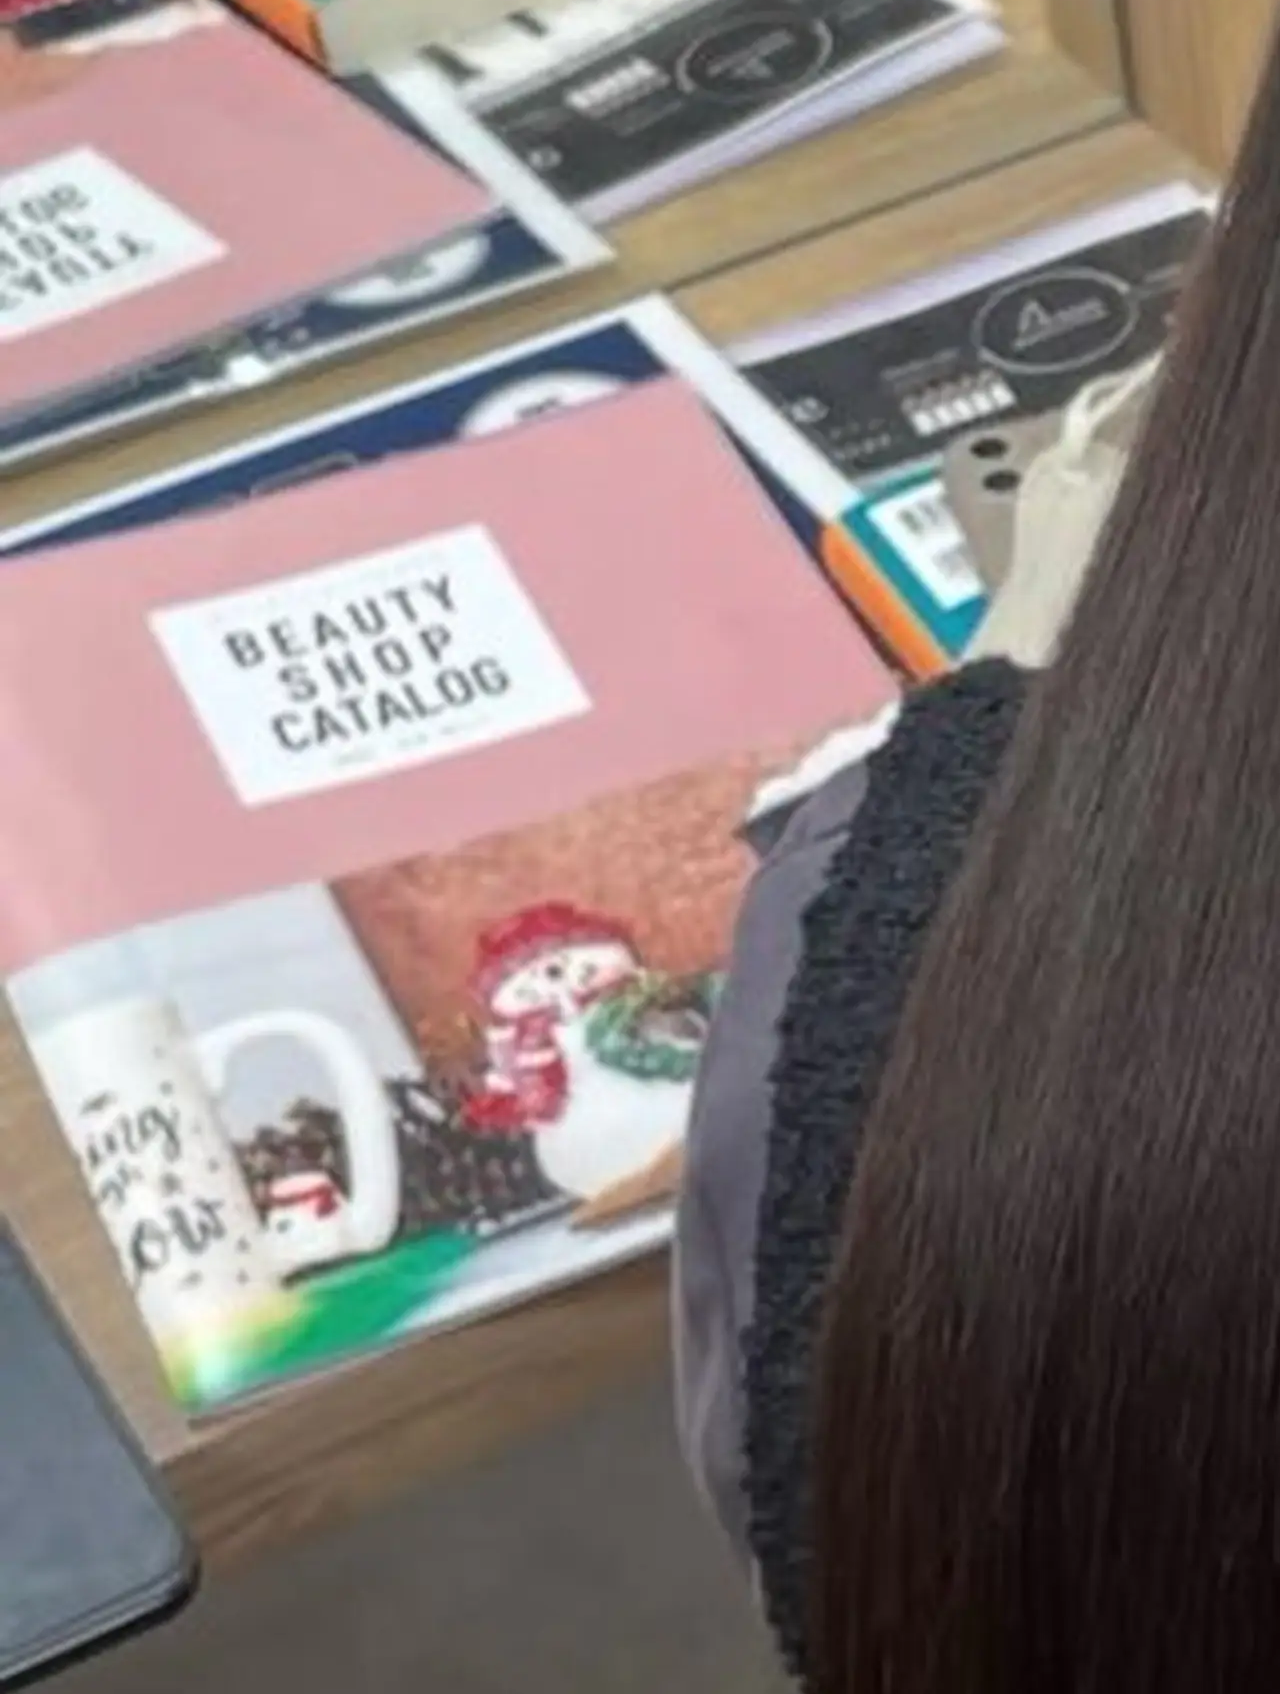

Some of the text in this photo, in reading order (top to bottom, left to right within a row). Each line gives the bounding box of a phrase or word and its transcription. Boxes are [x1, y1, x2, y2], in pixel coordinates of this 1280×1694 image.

[224, 572, 457, 671] BEAUTY
[277, 622, 452, 705] SHOP
[271, 655, 512, 754] CATALOG
